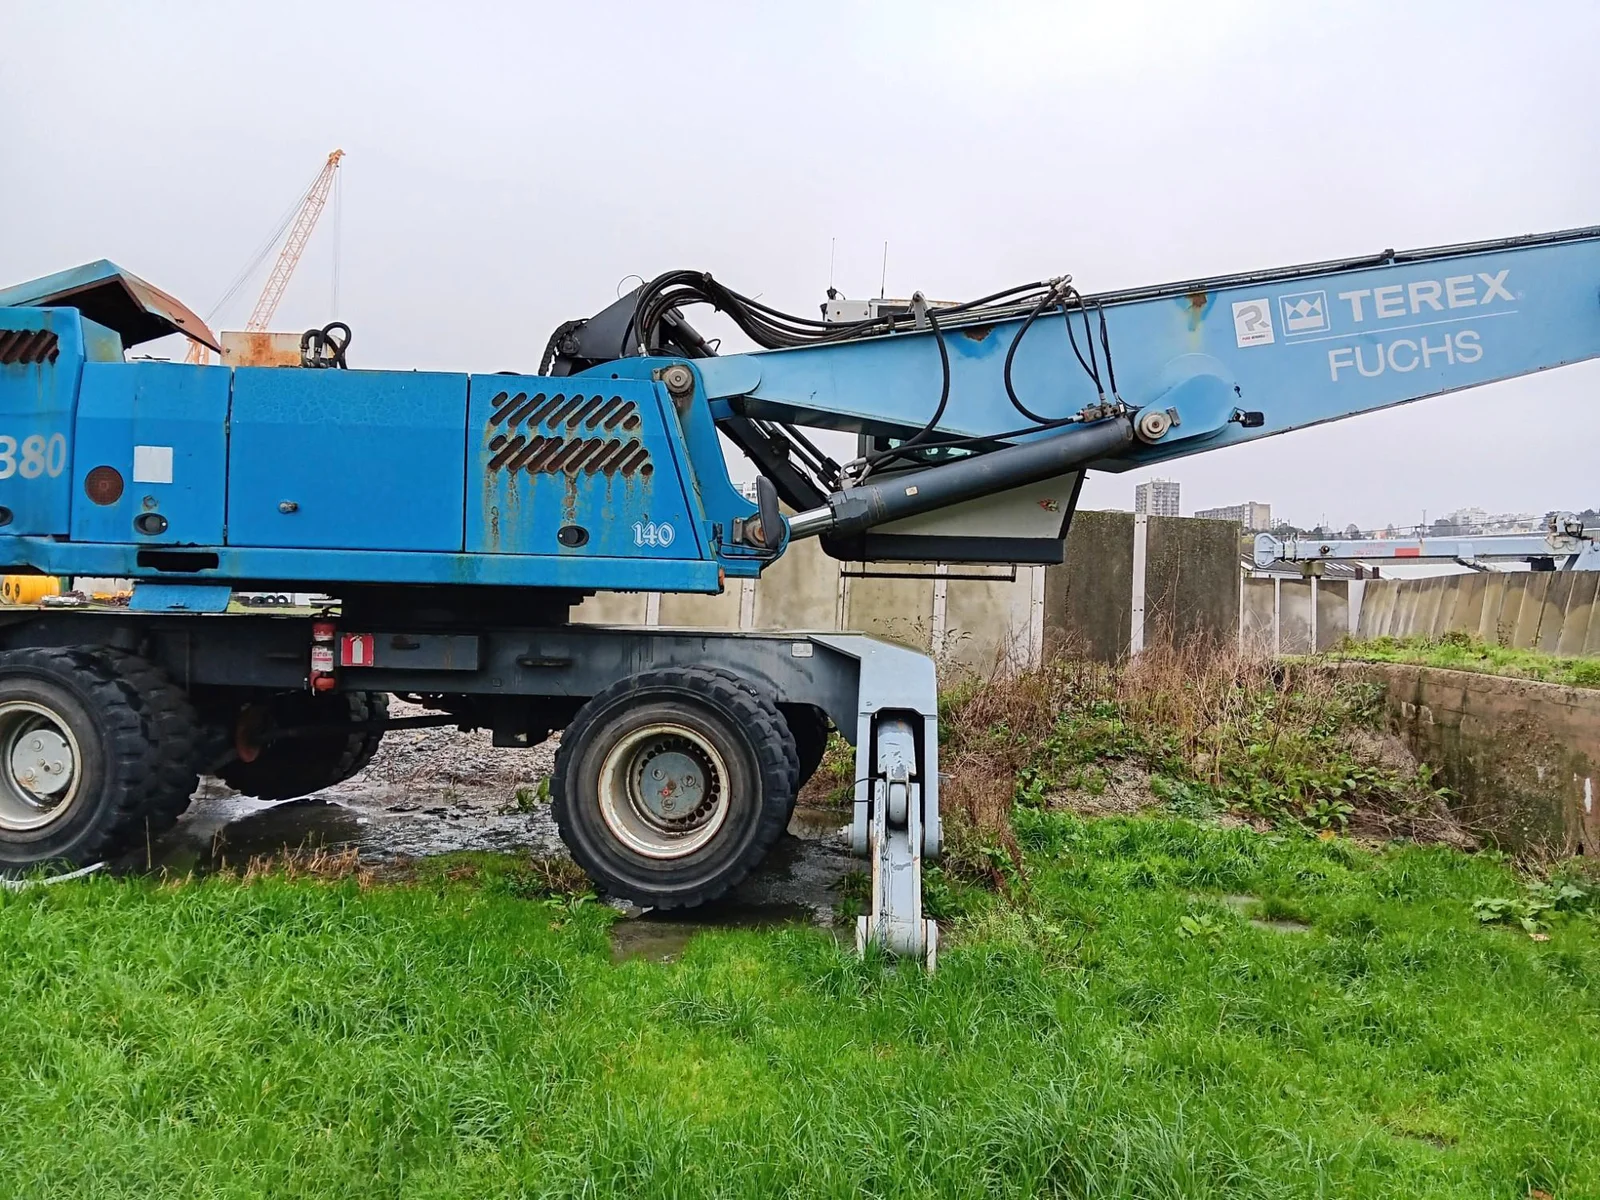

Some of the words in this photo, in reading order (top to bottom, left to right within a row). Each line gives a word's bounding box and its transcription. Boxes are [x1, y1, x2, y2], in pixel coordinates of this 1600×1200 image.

[1339, 270, 1515, 322] TEREX
[1328, 330, 1483, 381] FUCHS
[632, 520, 676, 548] 140
